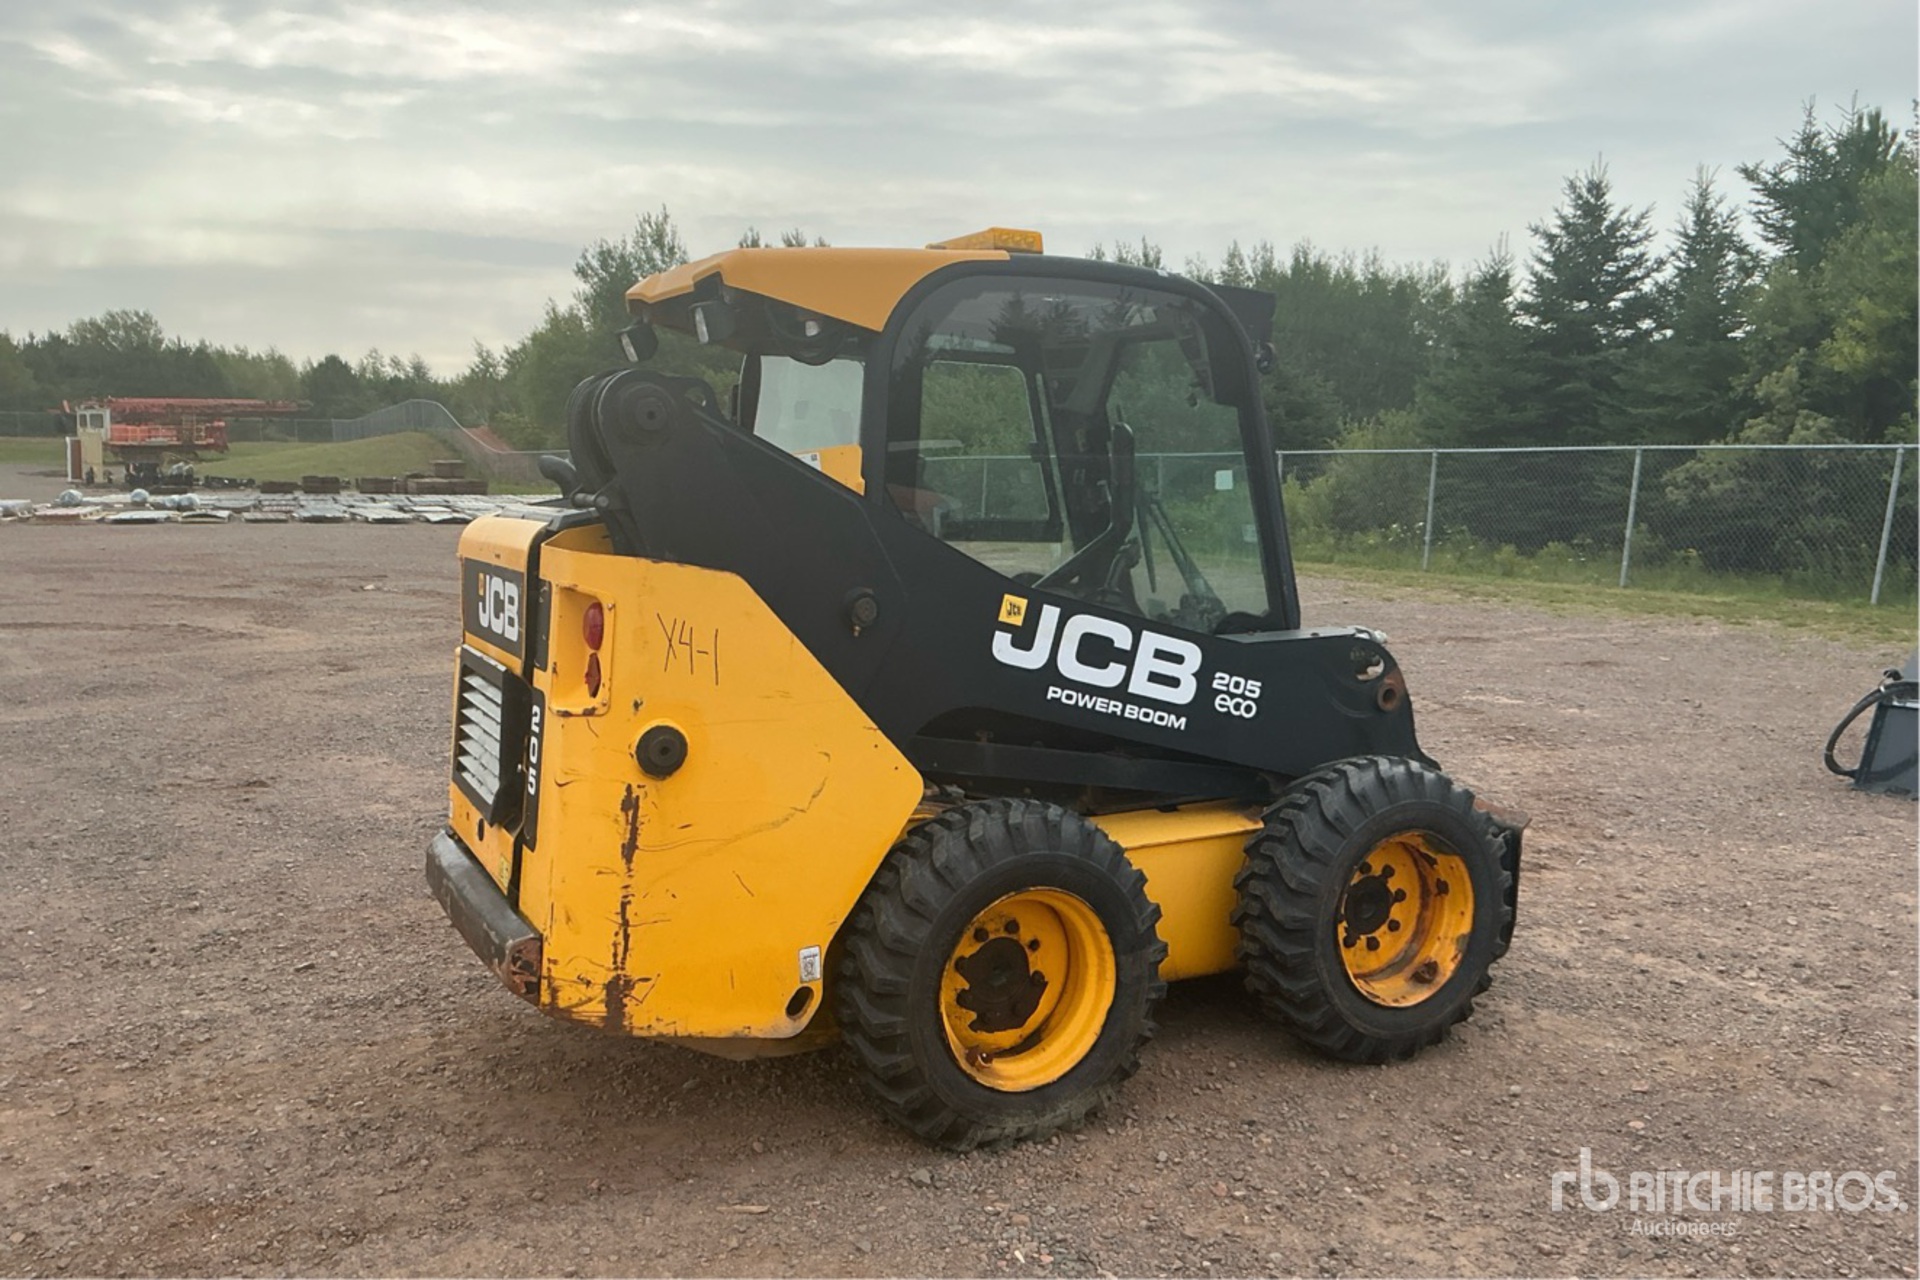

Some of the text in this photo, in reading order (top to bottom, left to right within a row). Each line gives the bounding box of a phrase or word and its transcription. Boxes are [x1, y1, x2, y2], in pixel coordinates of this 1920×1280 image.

[478, 574, 519, 642] JCB
[656, 612, 719, 686] X4-1
[991, 603, 1203, 705] JCB
[1046, 685, 1187, 731] POWER BOOM
[1211, 671, 1262, 699] 205
[1214, 693, 1257, 719] eco
[527, 704, 541, 796] 205
